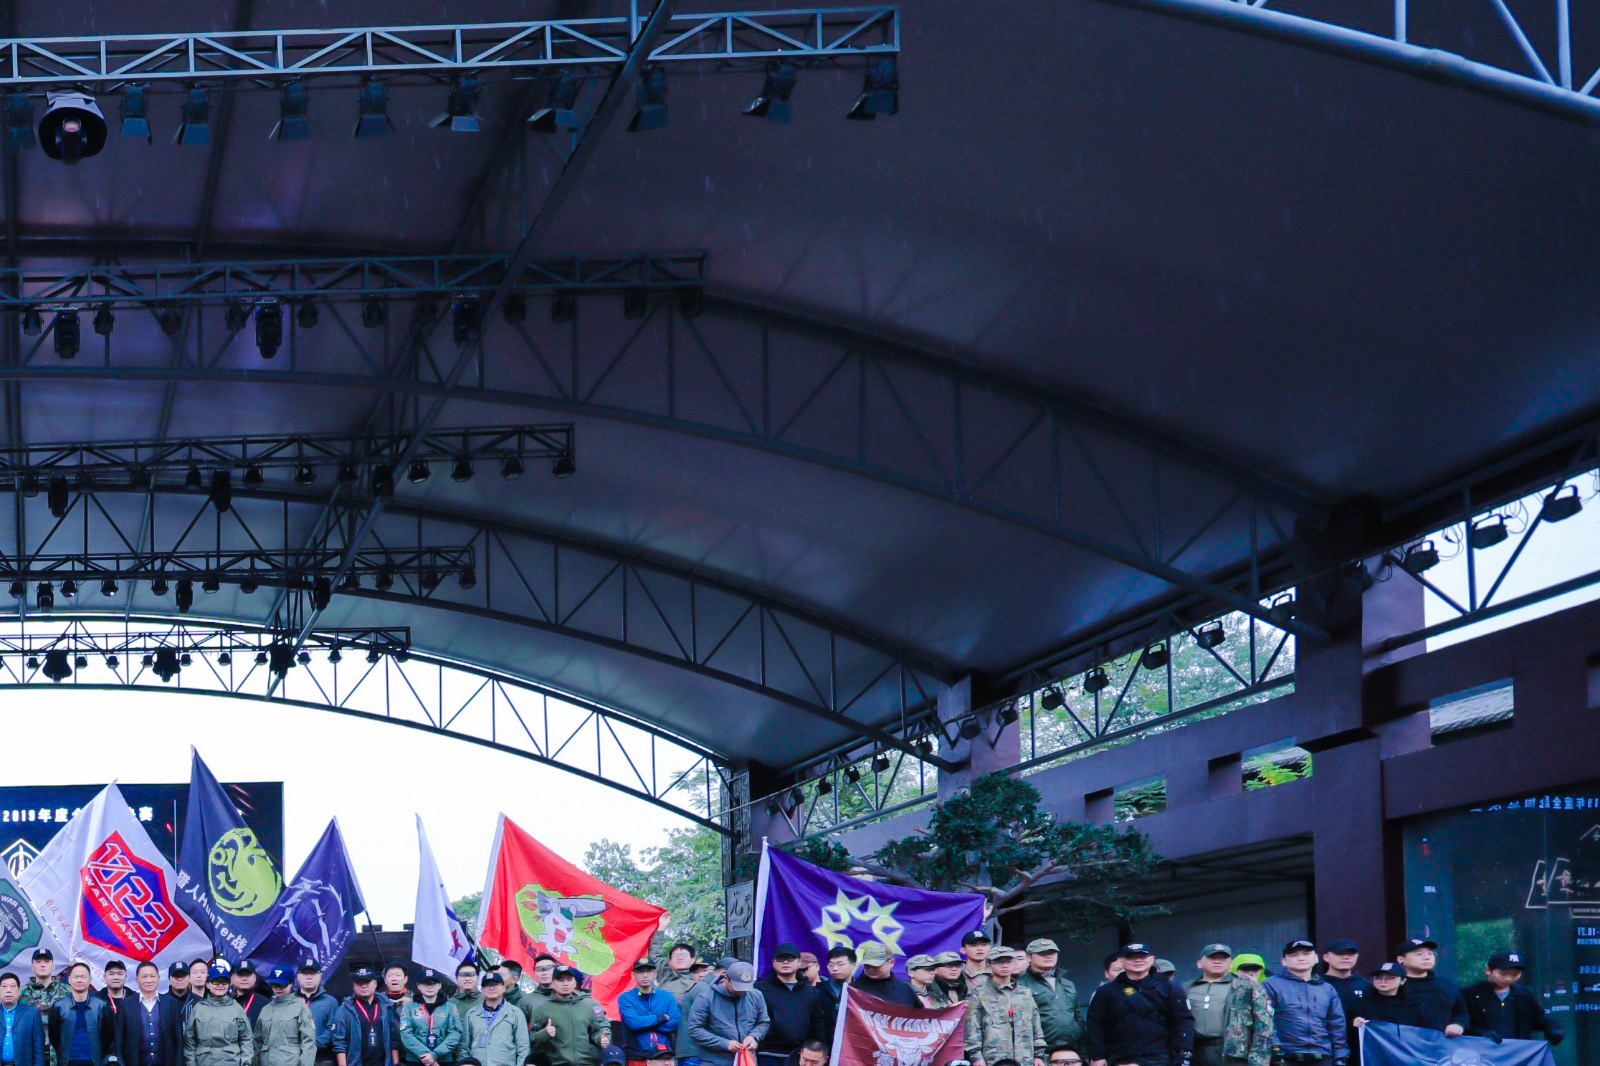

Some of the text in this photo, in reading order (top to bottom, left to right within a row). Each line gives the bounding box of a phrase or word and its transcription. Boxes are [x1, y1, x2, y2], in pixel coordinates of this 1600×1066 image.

[0, 894, 18, 908] WAR
[17, 906, 29, 931] GAME
[84, 874, 145, 951] WAR GAME
